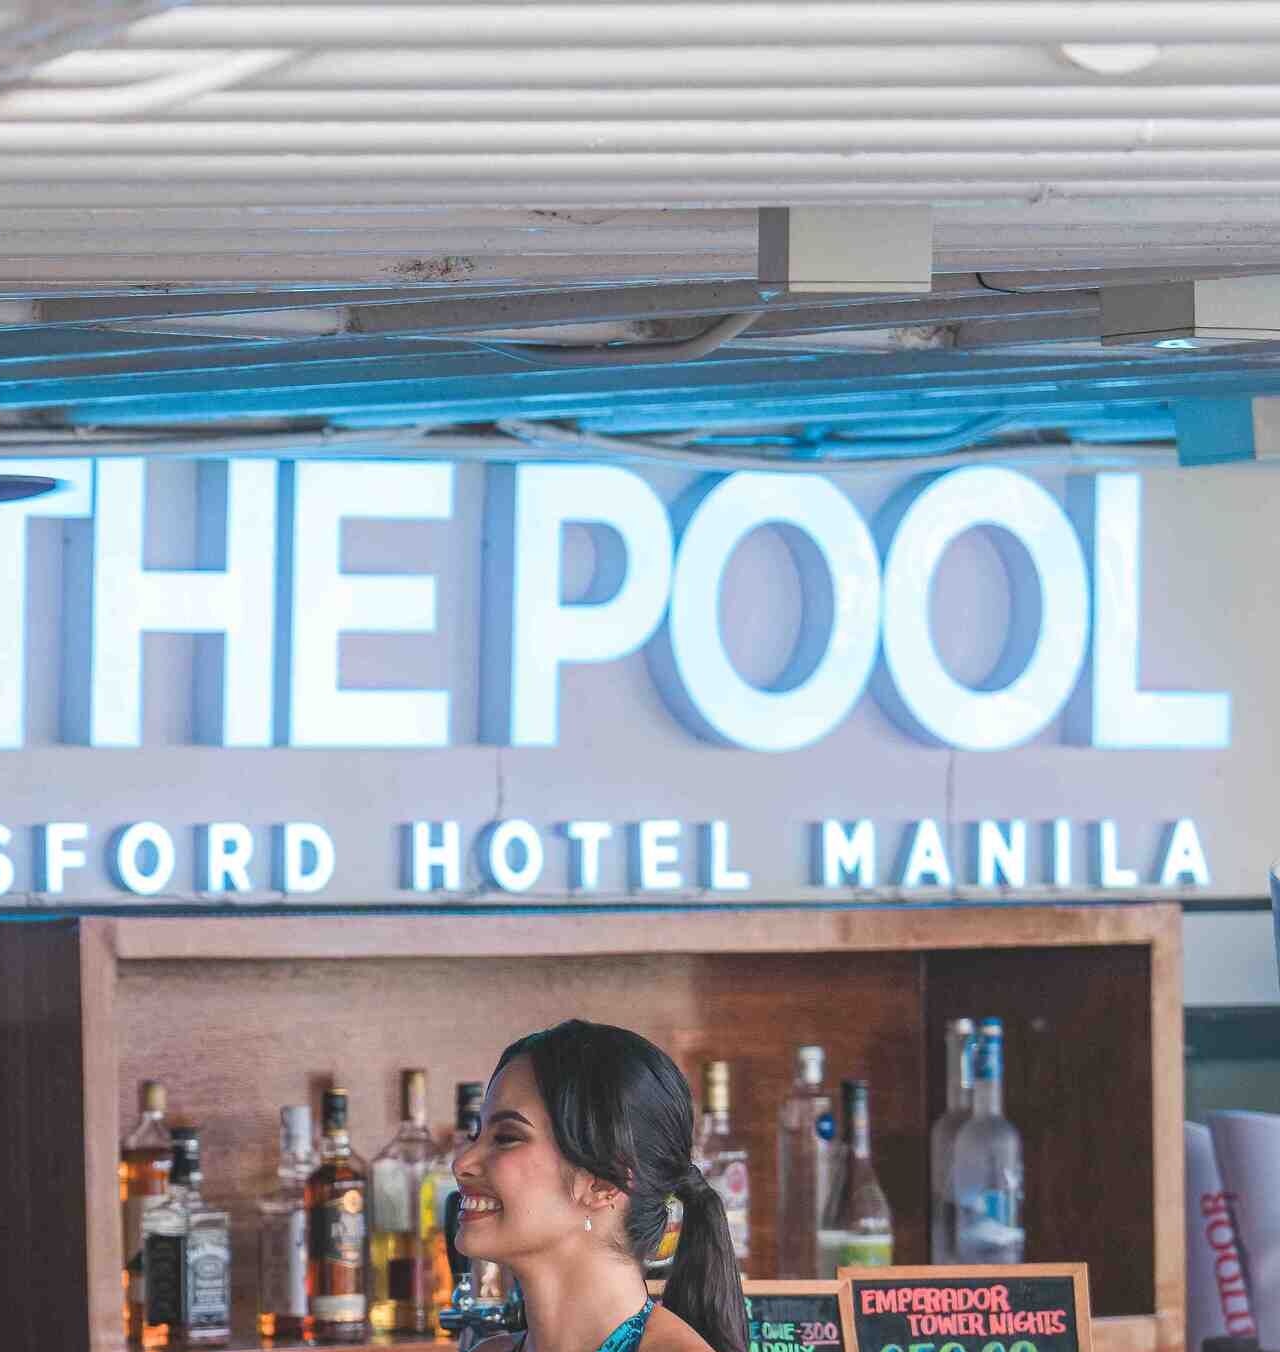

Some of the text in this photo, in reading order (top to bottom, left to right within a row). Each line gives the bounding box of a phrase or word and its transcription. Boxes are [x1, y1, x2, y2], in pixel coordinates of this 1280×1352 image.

[510, 463, 1231, 752] POOL
[410, 818, 750, 892] HOTEL
[822, 817, 1211, 888] MANILA
[860, 1284, 1010, 1315] EMPERADOR
[907, 1310, 1067, 1337] TOWER NIGHTS
